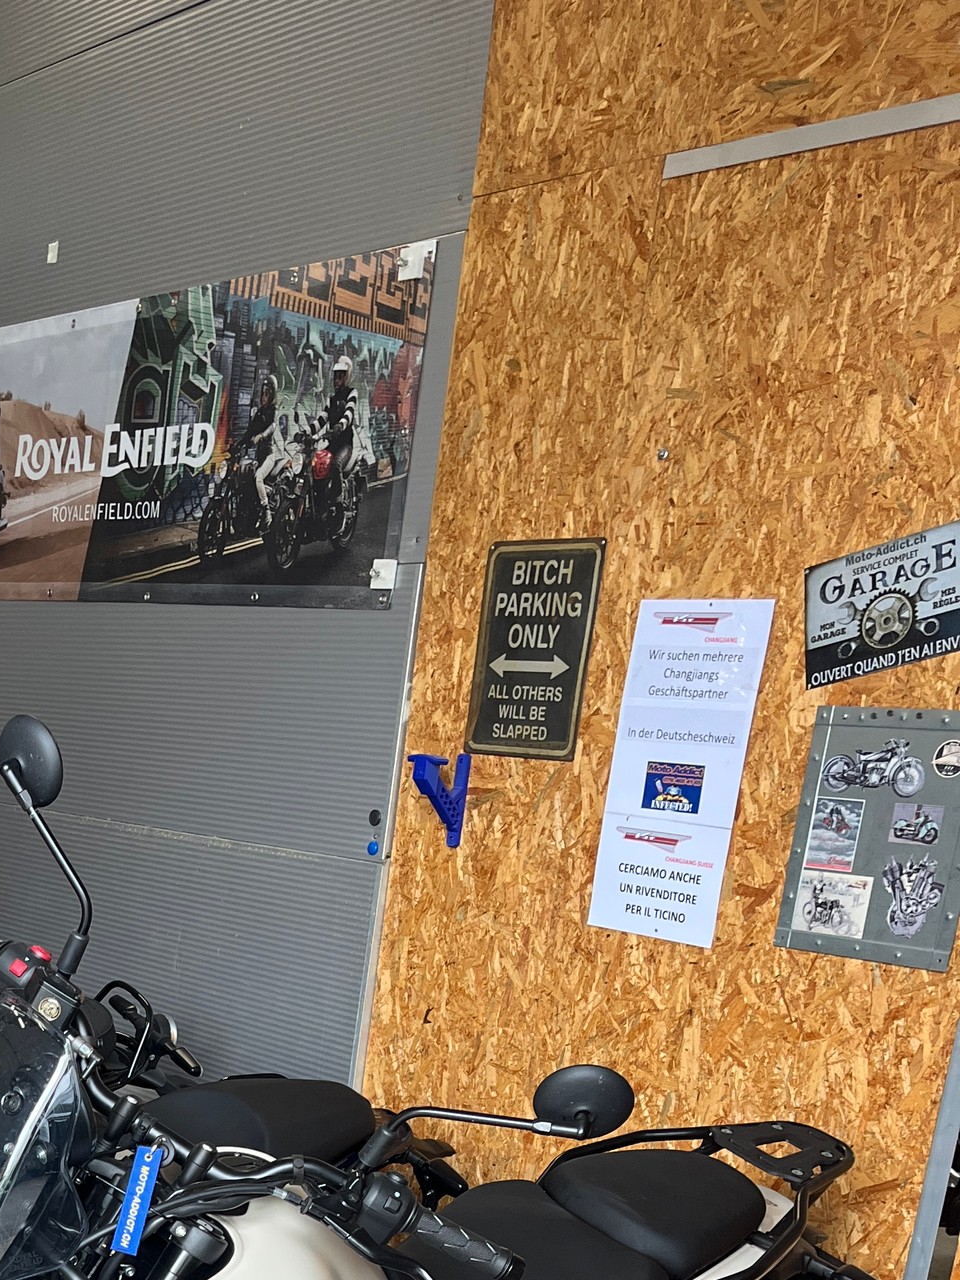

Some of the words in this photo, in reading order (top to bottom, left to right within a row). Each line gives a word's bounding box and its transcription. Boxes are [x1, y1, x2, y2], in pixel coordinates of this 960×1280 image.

[14, 433, 96, 481] ROYAL
[100, 422, 216, 478] ENFIELD
[51, 500, 161, 522] ROYALENFIELD.COM
[845, 534, 927, 567] Moto-Addict.ch
[512, 559, 574, 586] BITCH
[819, 538, 957, 605] GARAGE
[852, 560, 882, 577] SERVICE
[882, 549, 919, 567] COMPLET
[941, 587, 956, 598] MES
[495, 591, 583, 618] PARKING
[508, 623, 560, 649] ONLY
[811, 627, 847, 644] GARAGE
[820, 621, 835, 632] MON
[649, 649, 665, 660] Wir
[667, 650, 700, 662] suchen
[702, 651, 744, 663] mehrere
[854, 654, 896, 676] QUAND
[897, 645, 920, 665] J'EN
[921, 641, 934, 658] AI
[663, 668, 719, 682] Changjiangs
[488, 684, 509, 699] ALL
[512, 685, 563, 702] OTHERS
[648, 685, 729, 700] Geschäftspartner
[498, 704, 526, 720] WILL
[529, 706, 546, 721] BE
[492, 724, 547, 741] SLAPPED
[627, 727, 636, 738] In
[639, 728, 654, 739] der
[656, 729, 736, 745] Deutscheschweiz
[648, 763, 672, 774] Moto
[673, 765, 704, 777] Addict
[651, 799, 693, 812] INFECTED!
[618, 862, 667, 880] CERCIAMO
[668, 870, 702, 886] ANCHE
[619, 882, 633, 894] UN
[635, 885, 698, 905] RIVENDITORE
[625, 903, 642, 914] PER
[644, 906, 652, 917] IL
[654, 908, 686, 923] TICINO
[120, 1165, 151, 1248] MOTO-ADDICT.CH
